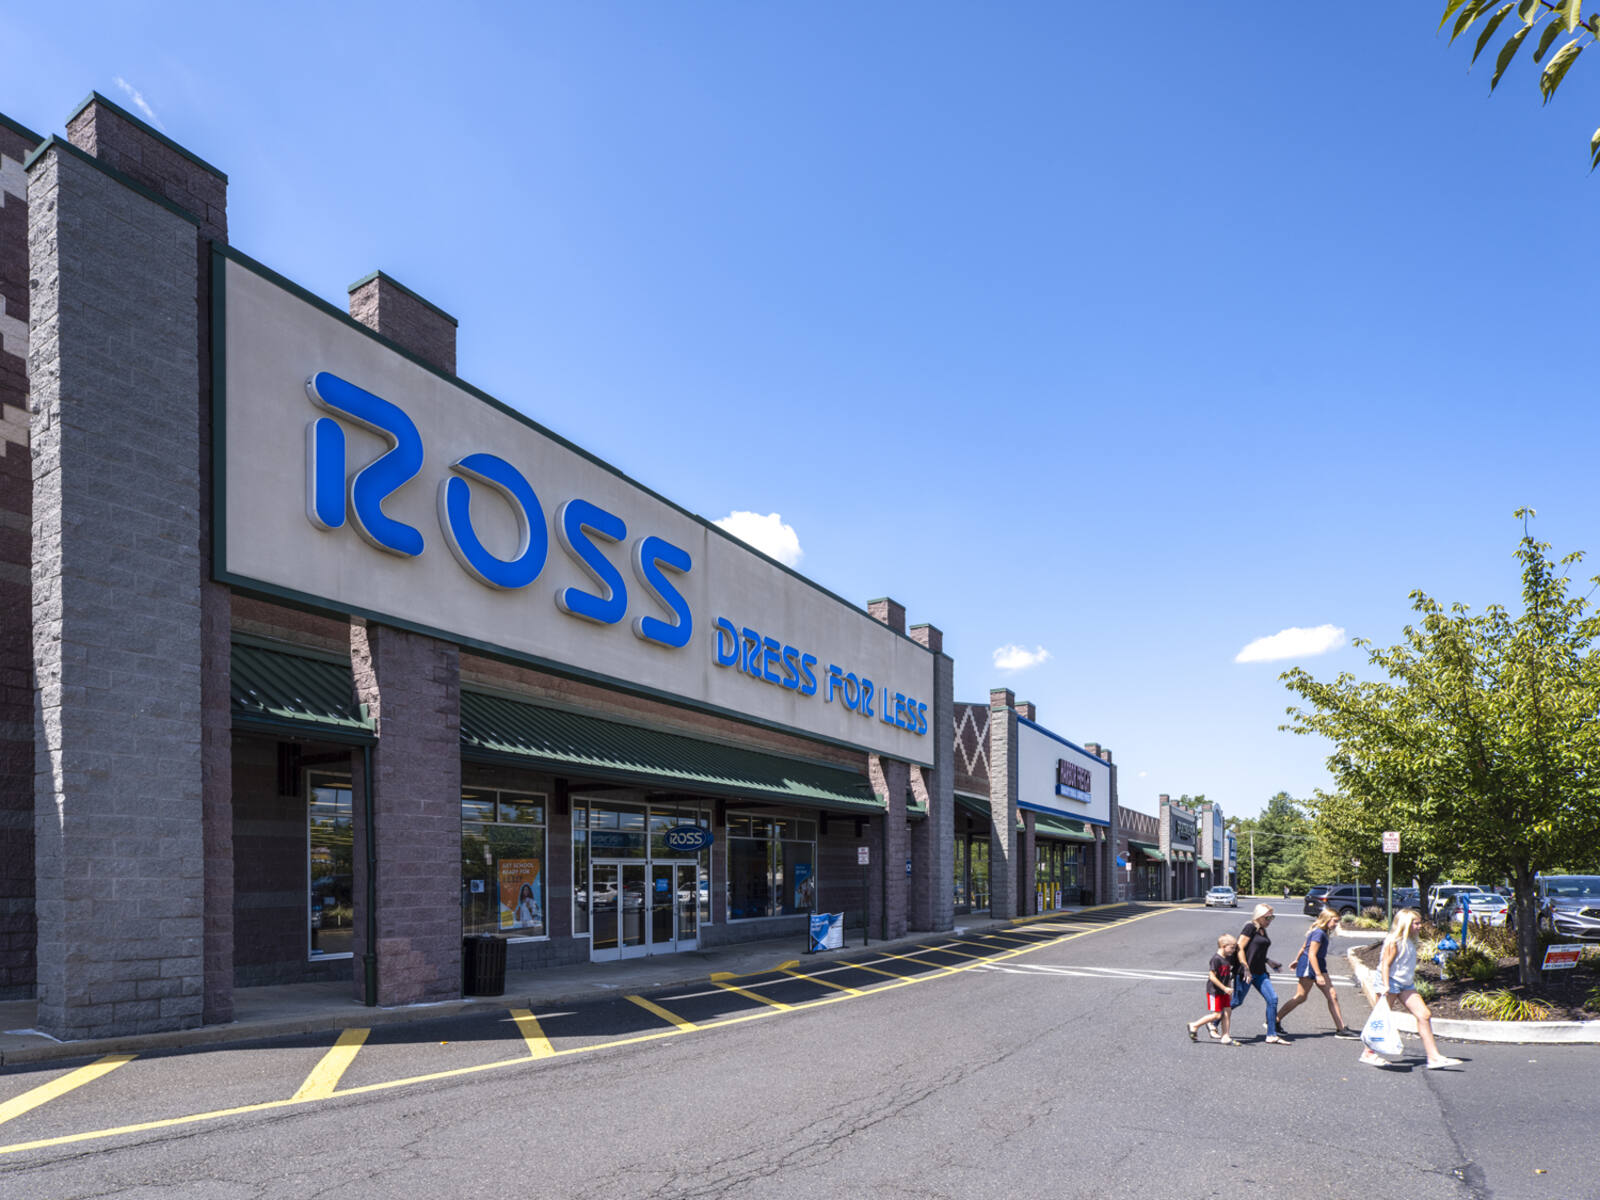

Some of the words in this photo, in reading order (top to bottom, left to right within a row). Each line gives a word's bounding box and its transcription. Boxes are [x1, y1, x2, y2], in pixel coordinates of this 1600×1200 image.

[306, 371, 693, 649] ROSS
[713, 616, 818, 696] DRESS
[825, 664, 875, 718] FOR
[880, 687, 928, 736] LESS
[669, 832, 702, 845] ROSS
